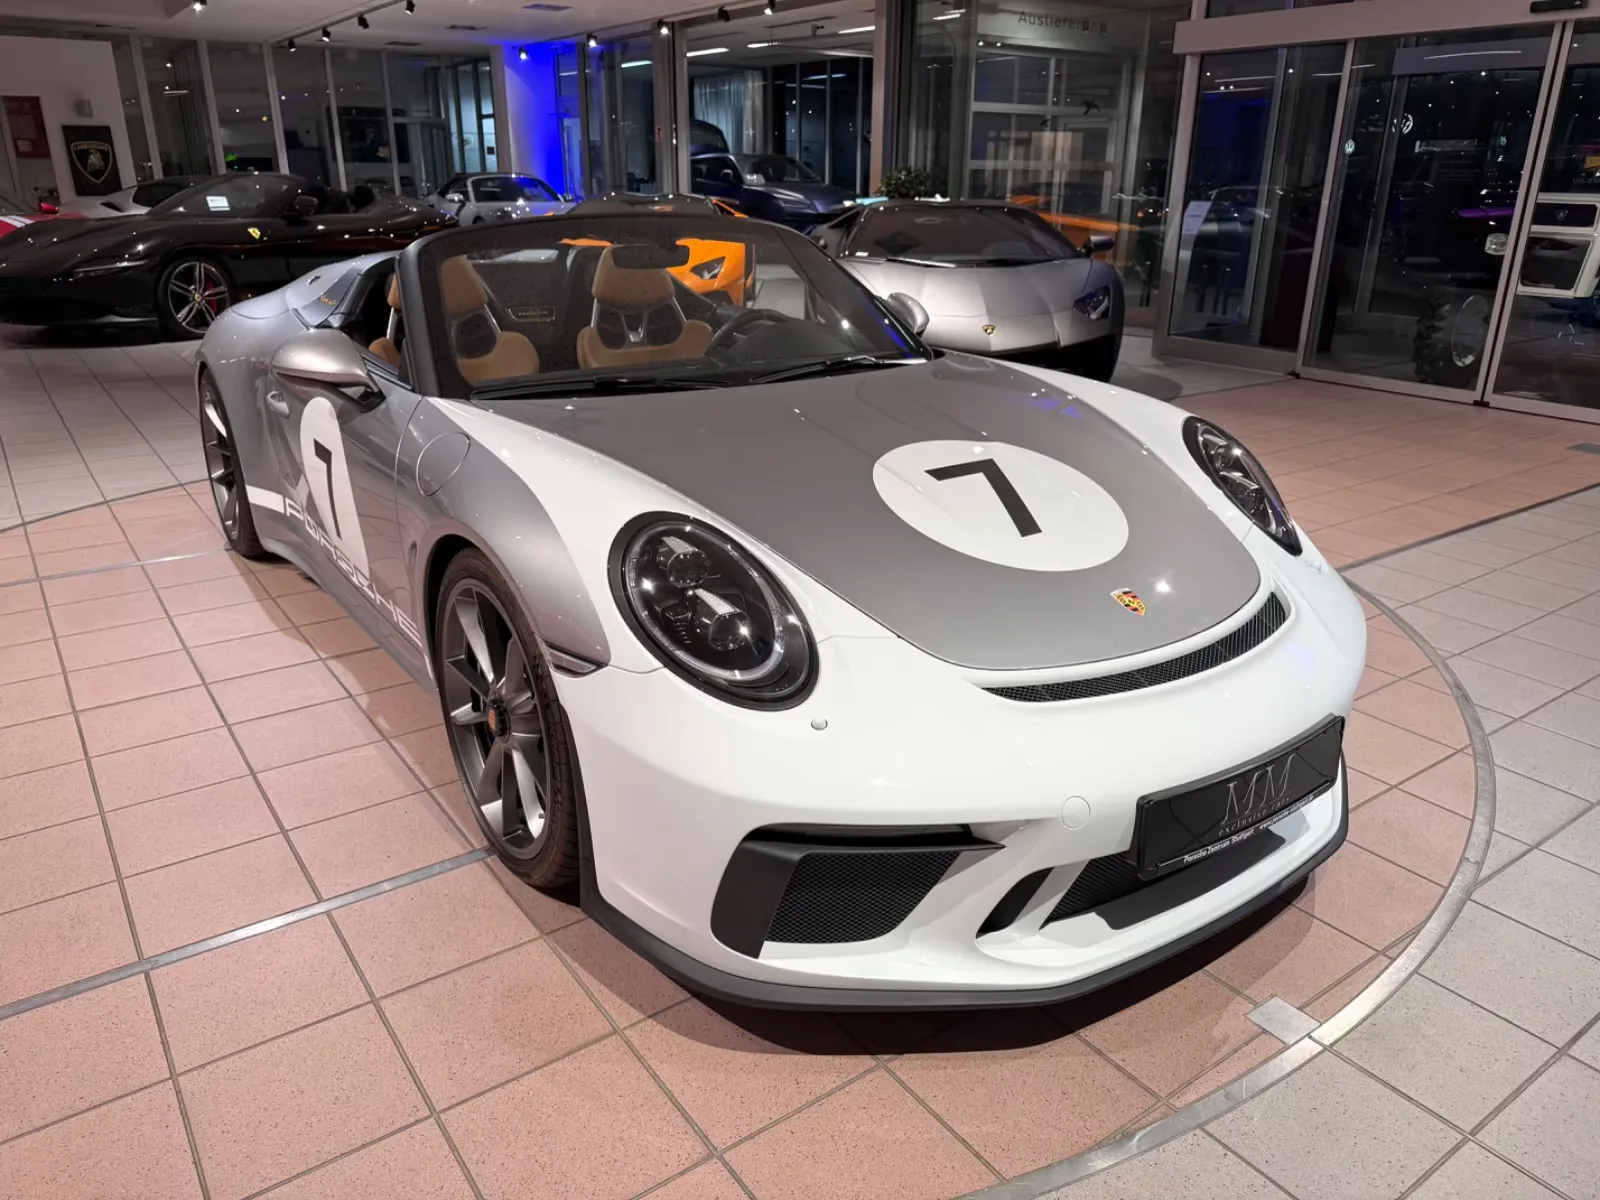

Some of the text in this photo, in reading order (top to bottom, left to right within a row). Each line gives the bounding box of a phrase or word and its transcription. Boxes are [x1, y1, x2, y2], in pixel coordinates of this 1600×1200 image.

[314, 438, 342, 541] 7
[924, 458, 1043, 538] 7
[284, 496, 423, 648] PORSCHE
[1183, 849, 1207, 863] Porsche
[1207, 840, 1231, 855] Zentrum
[1231, 829, 1255, 845] Stuttgart
